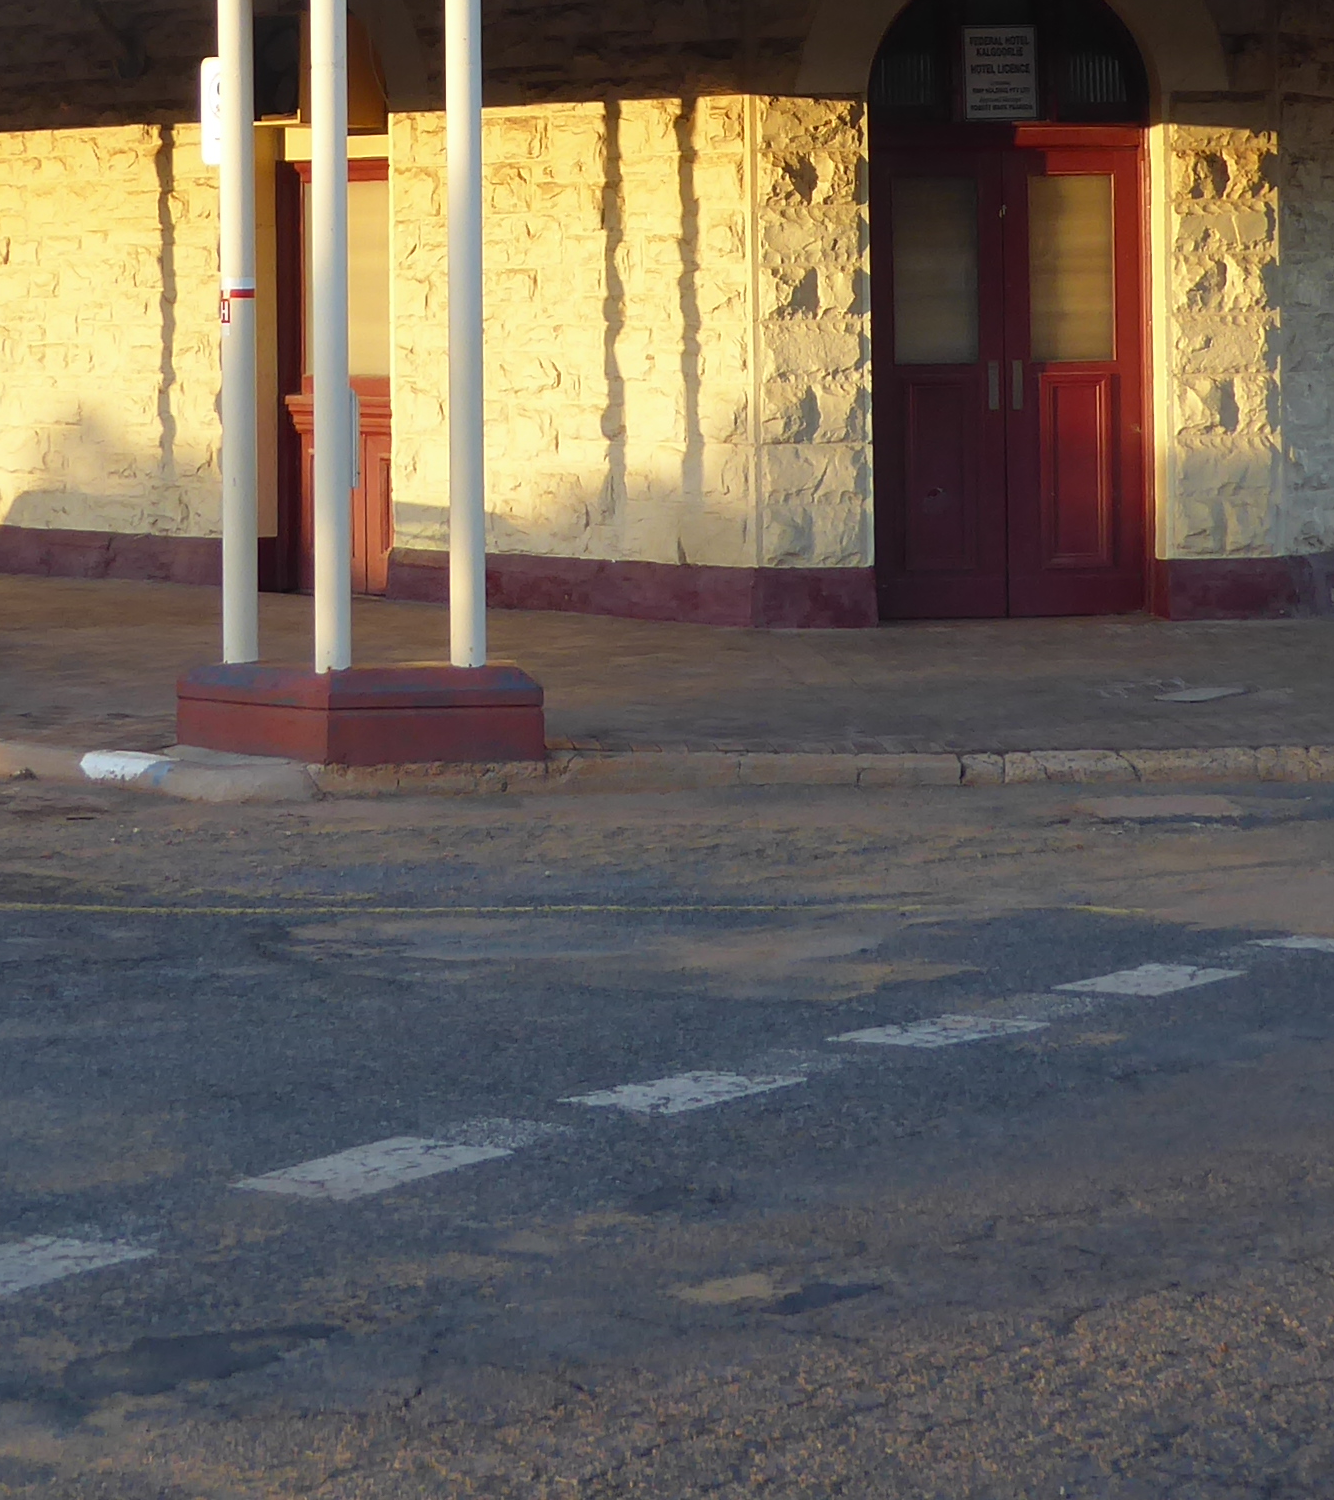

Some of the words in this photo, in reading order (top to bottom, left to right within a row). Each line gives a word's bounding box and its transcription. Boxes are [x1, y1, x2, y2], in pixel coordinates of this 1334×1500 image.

[969, 36, 1003, 46] FEDERAL
[1005, 35, 1030, 45] HOTEL
[970, 63, 996, 74] HOTEL
[997, 62, 1031, 74] LICENCE
